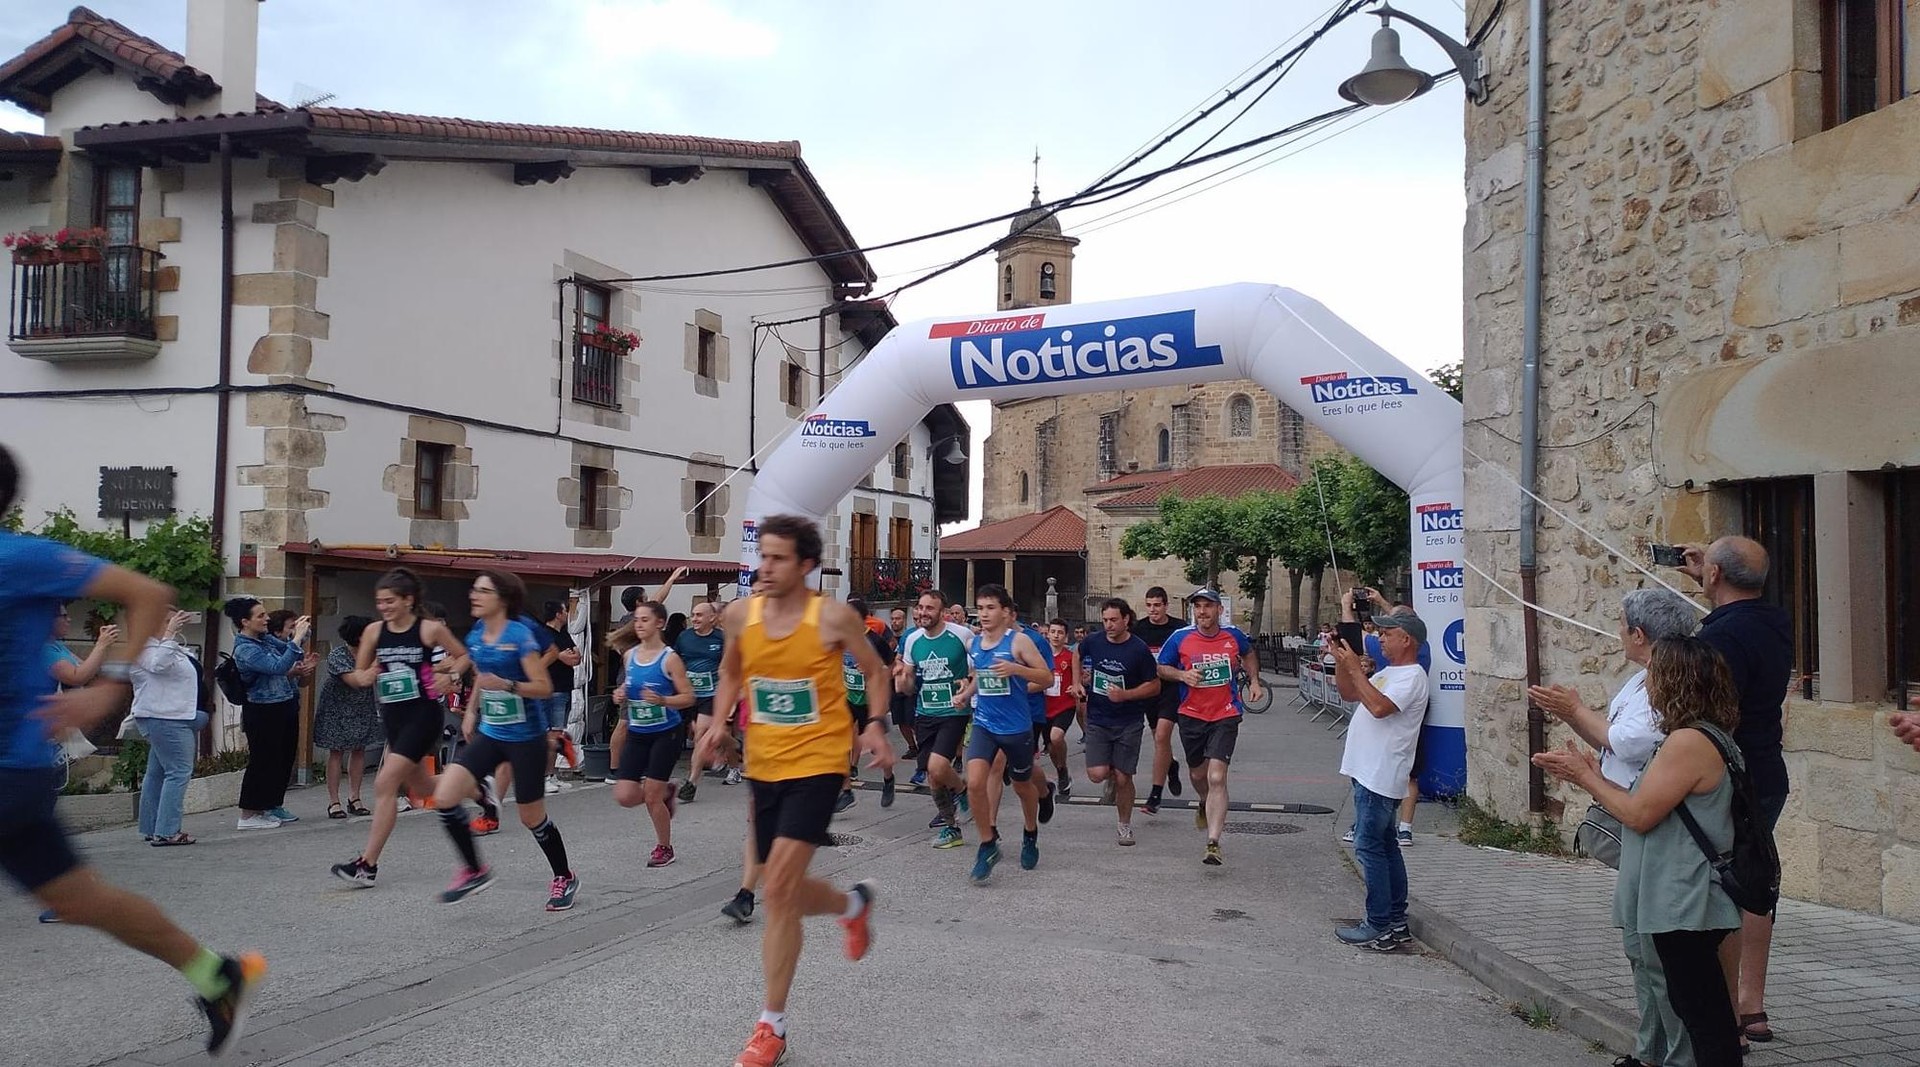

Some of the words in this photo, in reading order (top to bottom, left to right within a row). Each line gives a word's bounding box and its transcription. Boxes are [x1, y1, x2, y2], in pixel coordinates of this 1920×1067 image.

[965, 318, 1016, 335] Diario
[1020, 316, 1040, 330] de
[960, 325, 1177, 385] Noticias
[1315, 380, 1402, 402] Noticias
[1322, 406, 1342, 416] Eres
[1345, 404, 1354, 414] lo
[1357, 403, 1377, 415] que
[1381, 399, 1403, 410] lees
[803, 421, 864, 437] Noticias
[801, 438, 817, 448] Eres
[820, 440, 827, 449] lo
[829, 441, 845, 451] que
[847, 440, 865, 449] lees
[1426, 536, 1444, 546] Eres
[1447, 535, 1456, 545] lo
[1428, 593, 1446, 603] Eres
[1449, 592, 1458, 603] lo
[1205, 668, 1220, 680] 26
[385, 680, 405, 694] 79
[982, 678, 1003, 688] 104
[931, 691, 939, 701] 2
